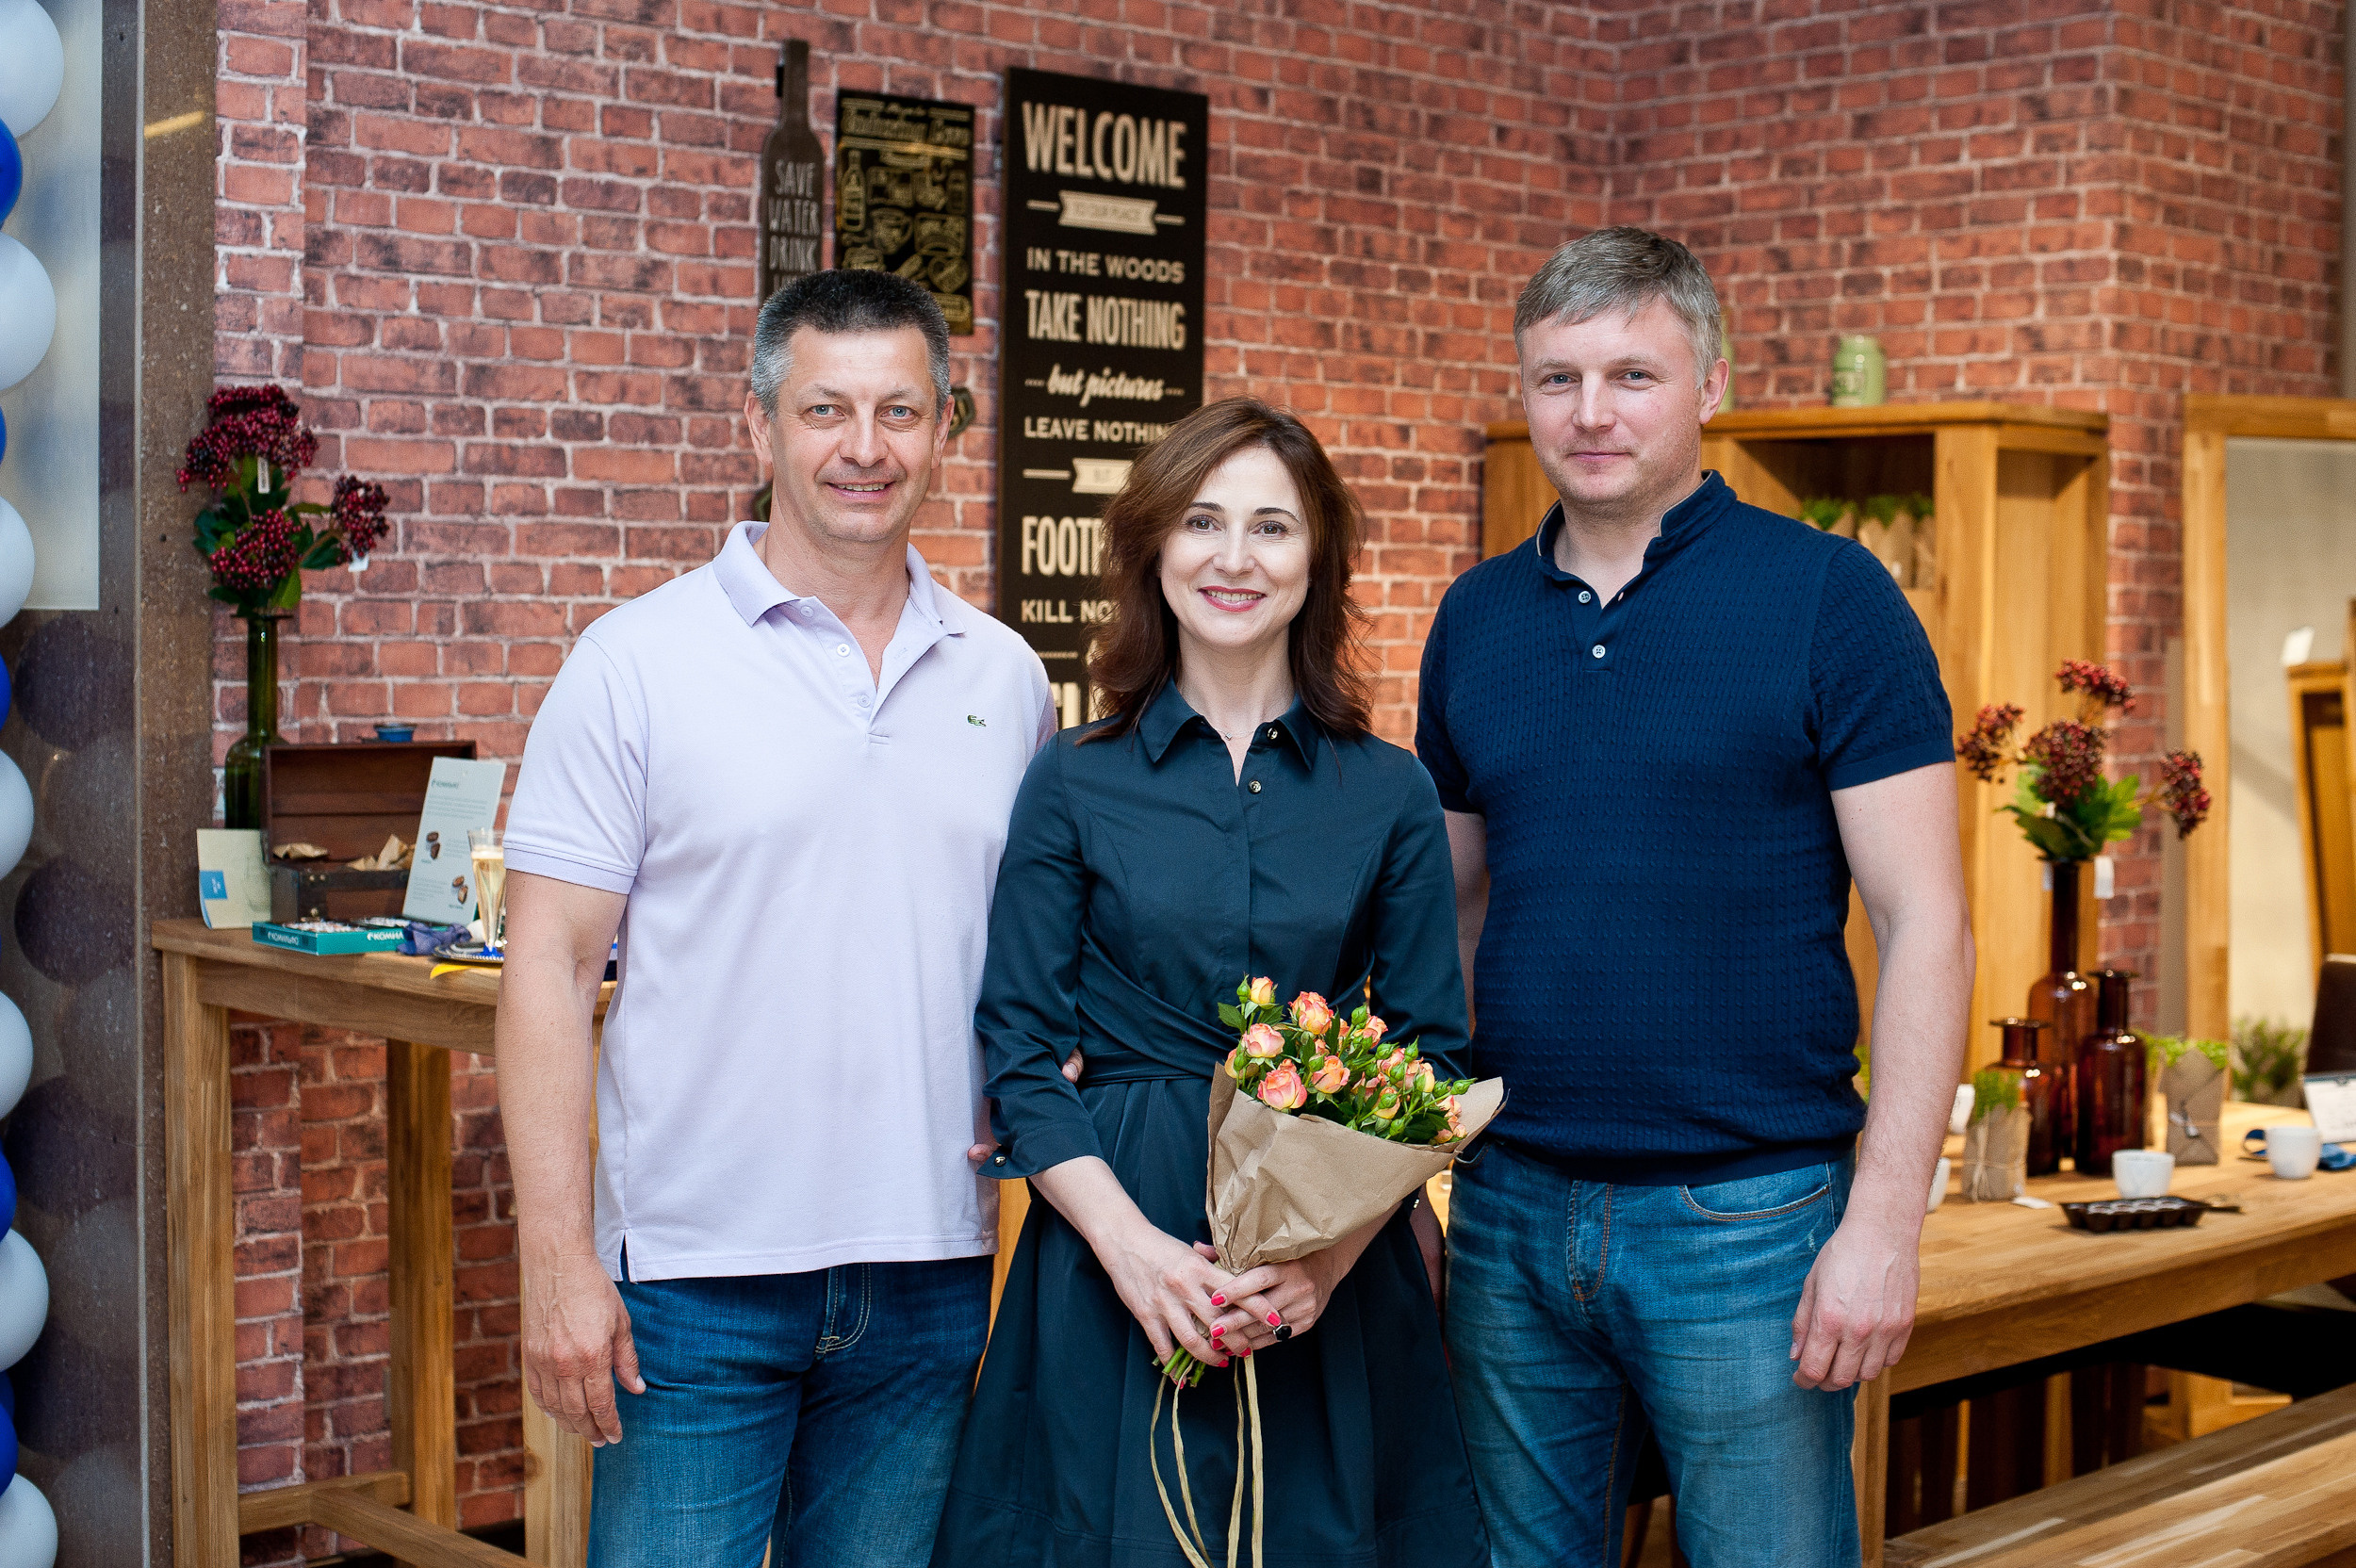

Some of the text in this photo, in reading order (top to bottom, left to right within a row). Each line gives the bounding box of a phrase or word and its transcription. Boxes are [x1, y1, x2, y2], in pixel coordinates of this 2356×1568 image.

[1023, 103, 1186, 188] WELCOME
[775, 159, 816, 197] SAVE
[768, 197, 820, 236] WATER
[769, 236, 817, 272] DRINK
[1026, 247, 1186, 285] IN THE WOODS
[1024, 289, 1186, 351] TAKE NOTHING
[1047, 363, 1165, 408] but pictures
[1023, 416, 1170, 445] LEAVE NOTHIN
[1021, 598, 1118, 624] KILL NO
